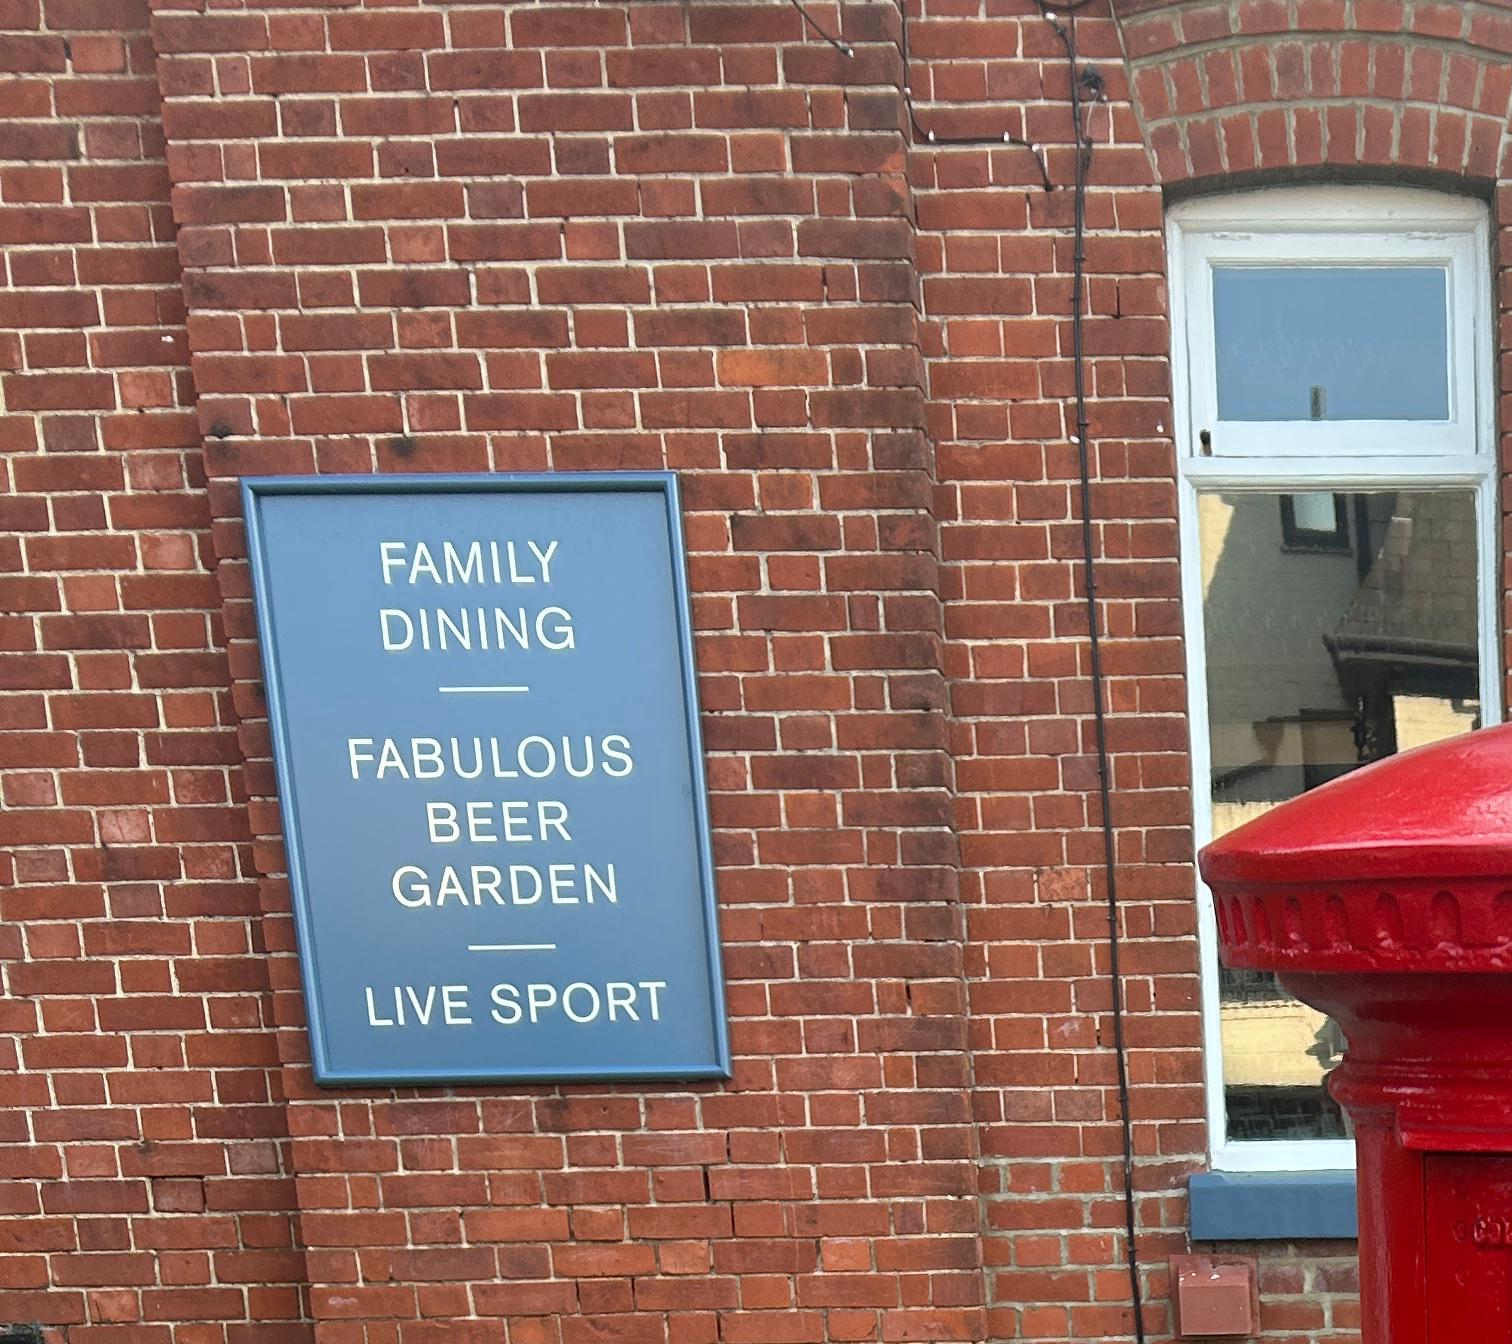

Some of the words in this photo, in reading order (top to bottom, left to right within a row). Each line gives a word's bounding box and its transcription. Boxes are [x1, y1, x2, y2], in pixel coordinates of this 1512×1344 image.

[379, 540, 559, 585] FAMILY
[379, 606, 576, 651] DINING
[347, 735, 635, 780] FABULOUS
[426, 801, 572, 844] BEER
[391, 863, 618, 908] GARDEN
[365, 985, 473, 1027] LIVE
[490, 980, 668, 1025] SPORT
